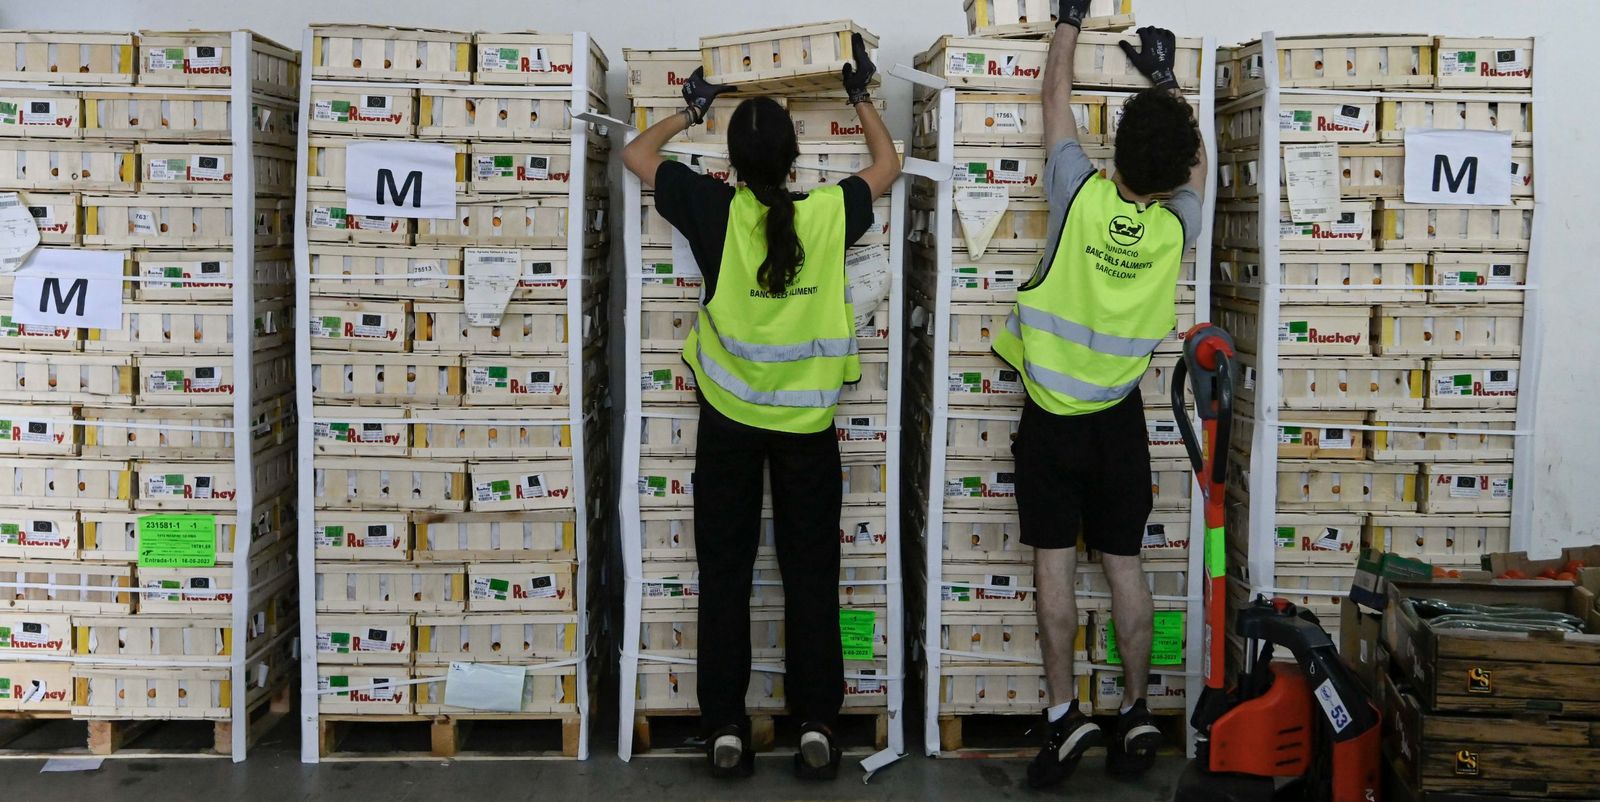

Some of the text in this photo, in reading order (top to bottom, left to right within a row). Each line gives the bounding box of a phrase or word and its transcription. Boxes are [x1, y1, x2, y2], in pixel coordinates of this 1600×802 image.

[830, 121, 865, 136] Ruch
[1431, 154, 1478, 194] M
[376, 168, 423, 208] M
[1103, 253, 1120, 266] DELS
[1095, 262, 1137, 279] BARCELONA
[39, 277, 89, 317] M
[1308, 328, 1361, 345] Ruchey
[184, 484, 237, 500] Rhey
[1330, 704, 1348, 728] 53
